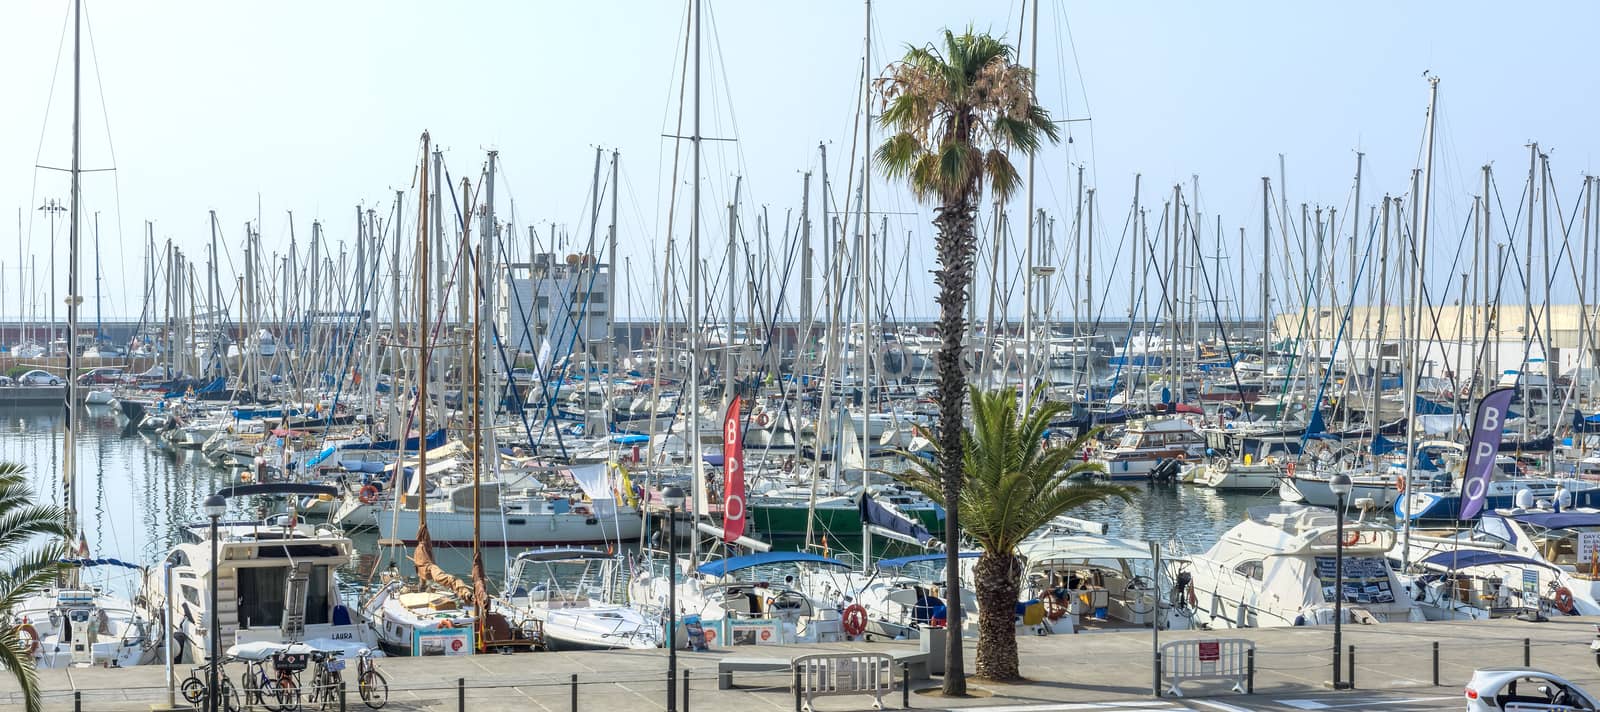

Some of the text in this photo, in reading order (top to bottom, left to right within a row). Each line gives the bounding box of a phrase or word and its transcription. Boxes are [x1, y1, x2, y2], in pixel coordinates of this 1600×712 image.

[725, 418, 744, 521] BPO
[1465, 406, 1500, 500] BPO
[331, 632, 353, 640] LAURA
